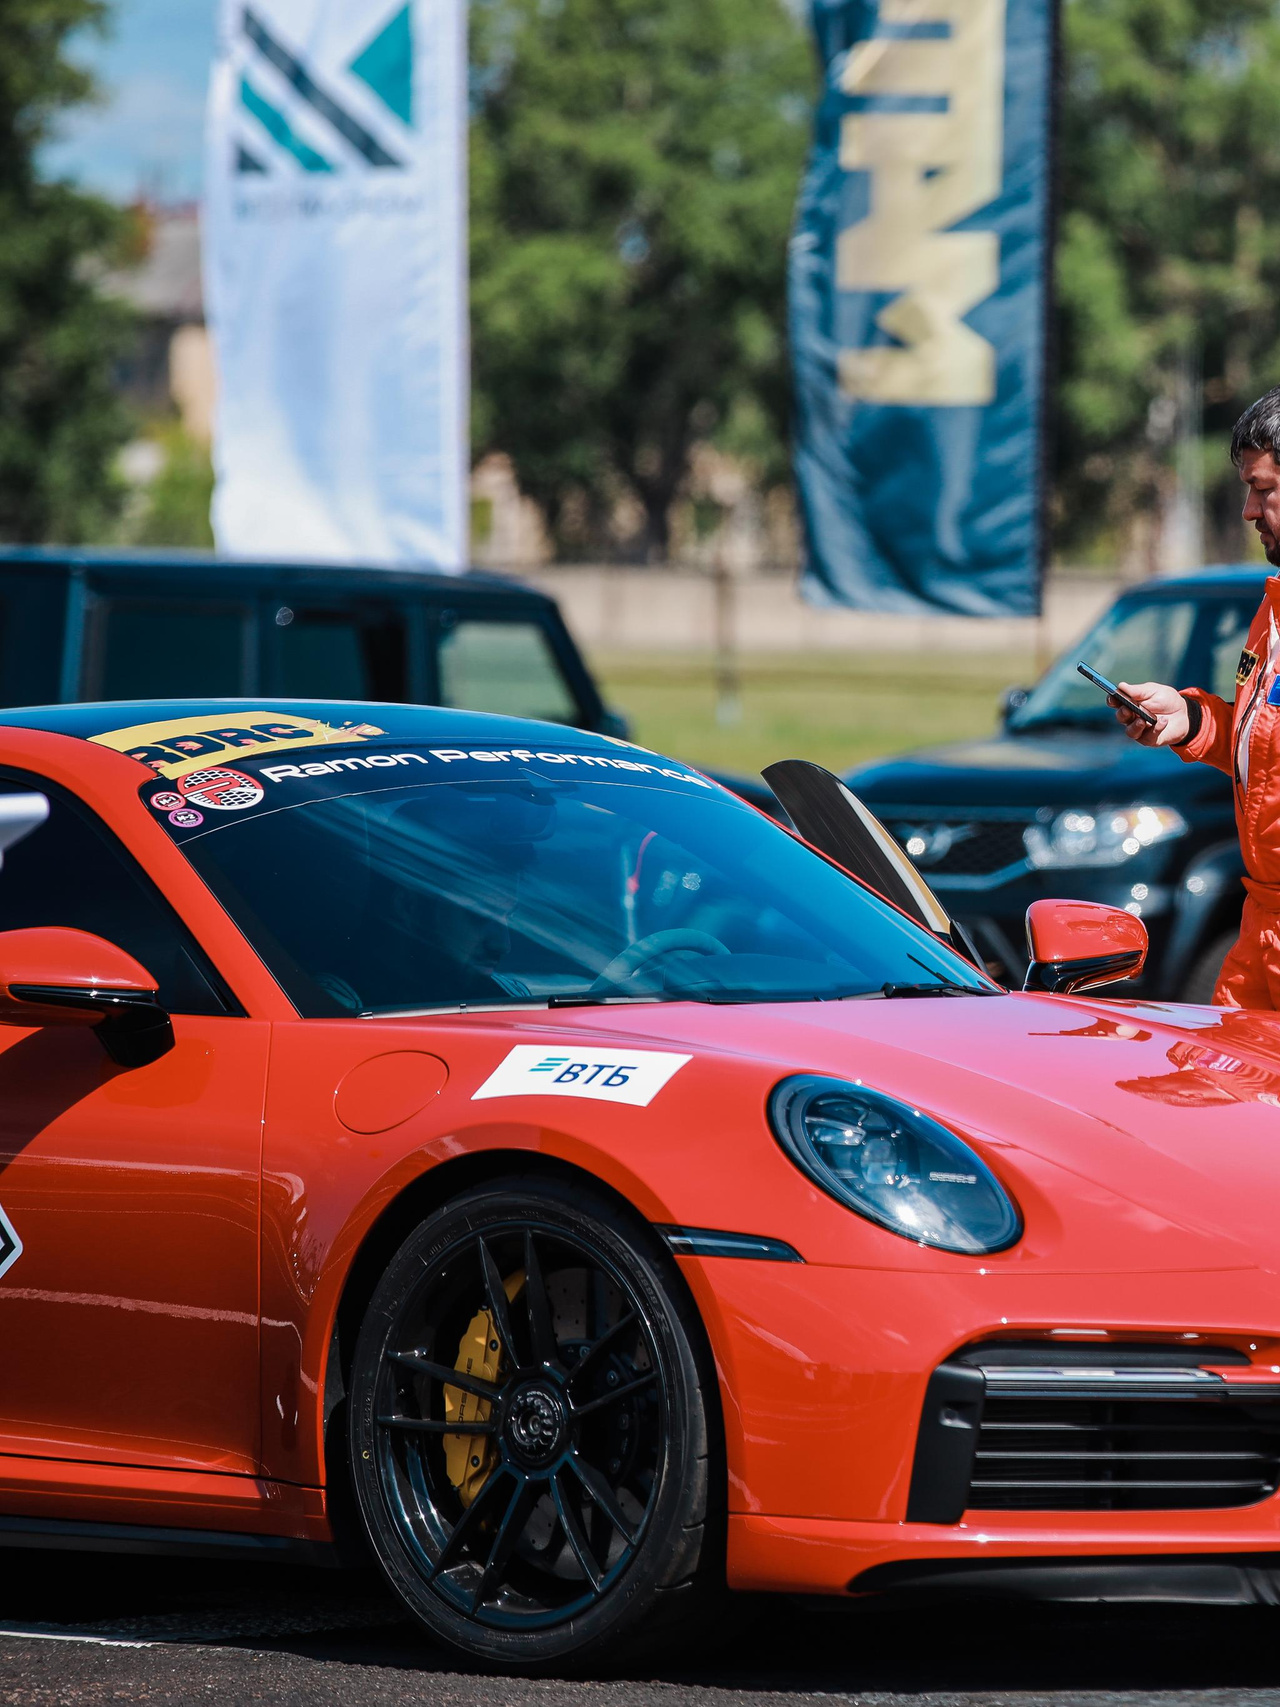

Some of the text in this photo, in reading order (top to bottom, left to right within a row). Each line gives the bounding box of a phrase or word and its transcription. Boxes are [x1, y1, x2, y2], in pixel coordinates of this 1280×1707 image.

[259, 749, 712, 789] Ramon Performance
[553, 1063, 638, 1087] ВТБ
